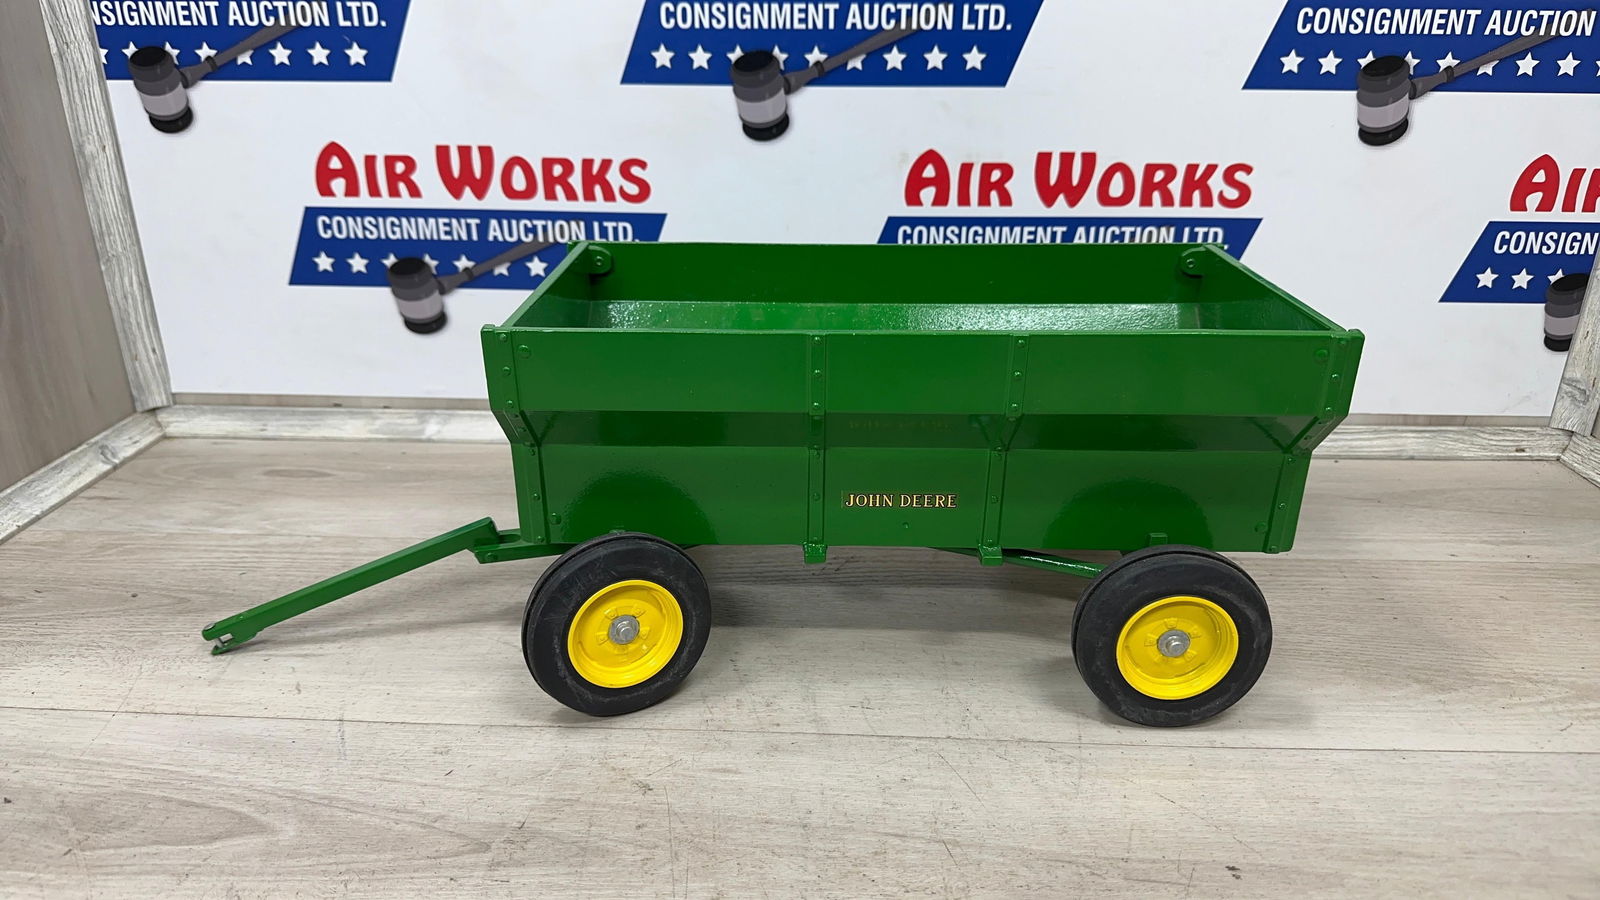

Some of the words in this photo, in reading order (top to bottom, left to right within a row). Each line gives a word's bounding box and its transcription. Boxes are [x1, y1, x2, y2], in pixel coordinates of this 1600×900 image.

[228, 1, 330, 27] AUCTION
[337, 2, 387, 27] LTD.
[660, 2, 839, 30] CONSIGNMENT
[846, 4, 953, 31] AUCTION
[962, 4, 1012, 31] LTD.
[1296, 7, 1482, 35] CONSIGNMENT
[1484, 9, 1597, 37] AUCTION
[315, 141, 422, 199] AIR
[435, 145, 651, 204] WORKS
[904, 149, 1014, 207] AIR
[1034, 151, 1254, 209] WORKS
[317, 215, 481, 242] CONSIGNMENT
[488, 218, 586, 244] AUCTION
[897, 225, 1067, 243] CONSIGNMENT
[1073, 226, 1175, 243] AUCTION
[845, 493, 894, 508] JOHN
[899, 493, 957, 509] DEERE
